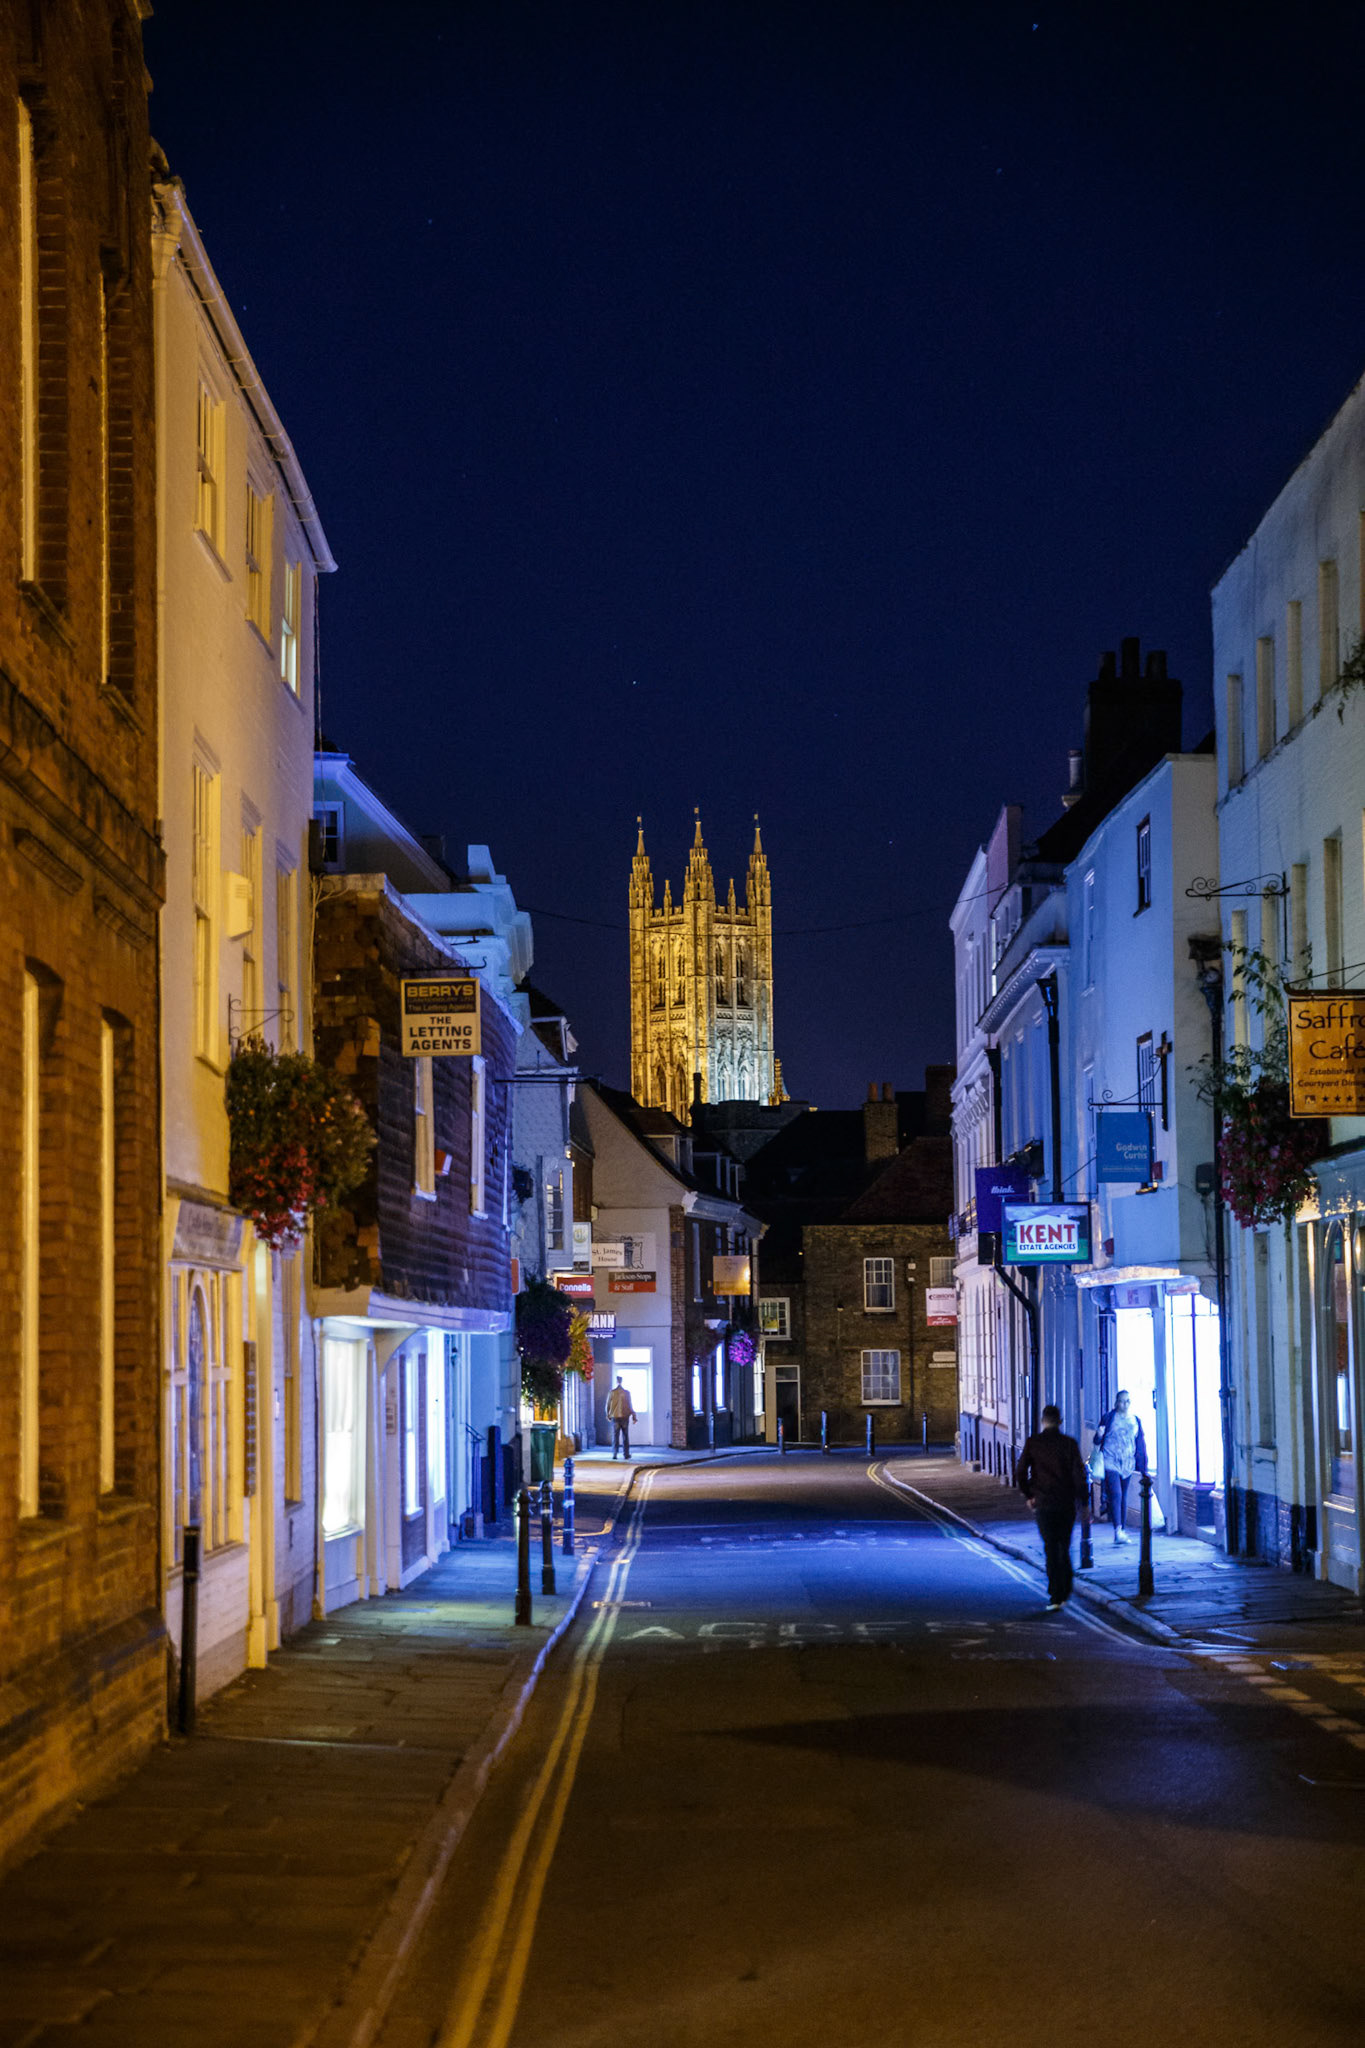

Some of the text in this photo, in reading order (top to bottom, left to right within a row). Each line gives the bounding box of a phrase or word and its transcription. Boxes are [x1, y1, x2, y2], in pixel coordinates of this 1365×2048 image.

[407, 984, 474, 998] BERRYS
[430, 1016, 451, 1025] THE
[409, 1026, 472, 1038] LETTING
[411, 1039, 471, 1051] AGENTS
[1309, 1033, 1365, 1059] Café
[1298, 1079, 1339, 1088] Courtyard
[1116, 1142, 1147, 1152] Godwin
[1020, 1224, 1076, 1244] KENT
[603, 1247, 623, 1256] James
[1019, 1243, 1076, 1251] ESTATE AGENCIES
[560, 1283, 592, 1292] Connells
